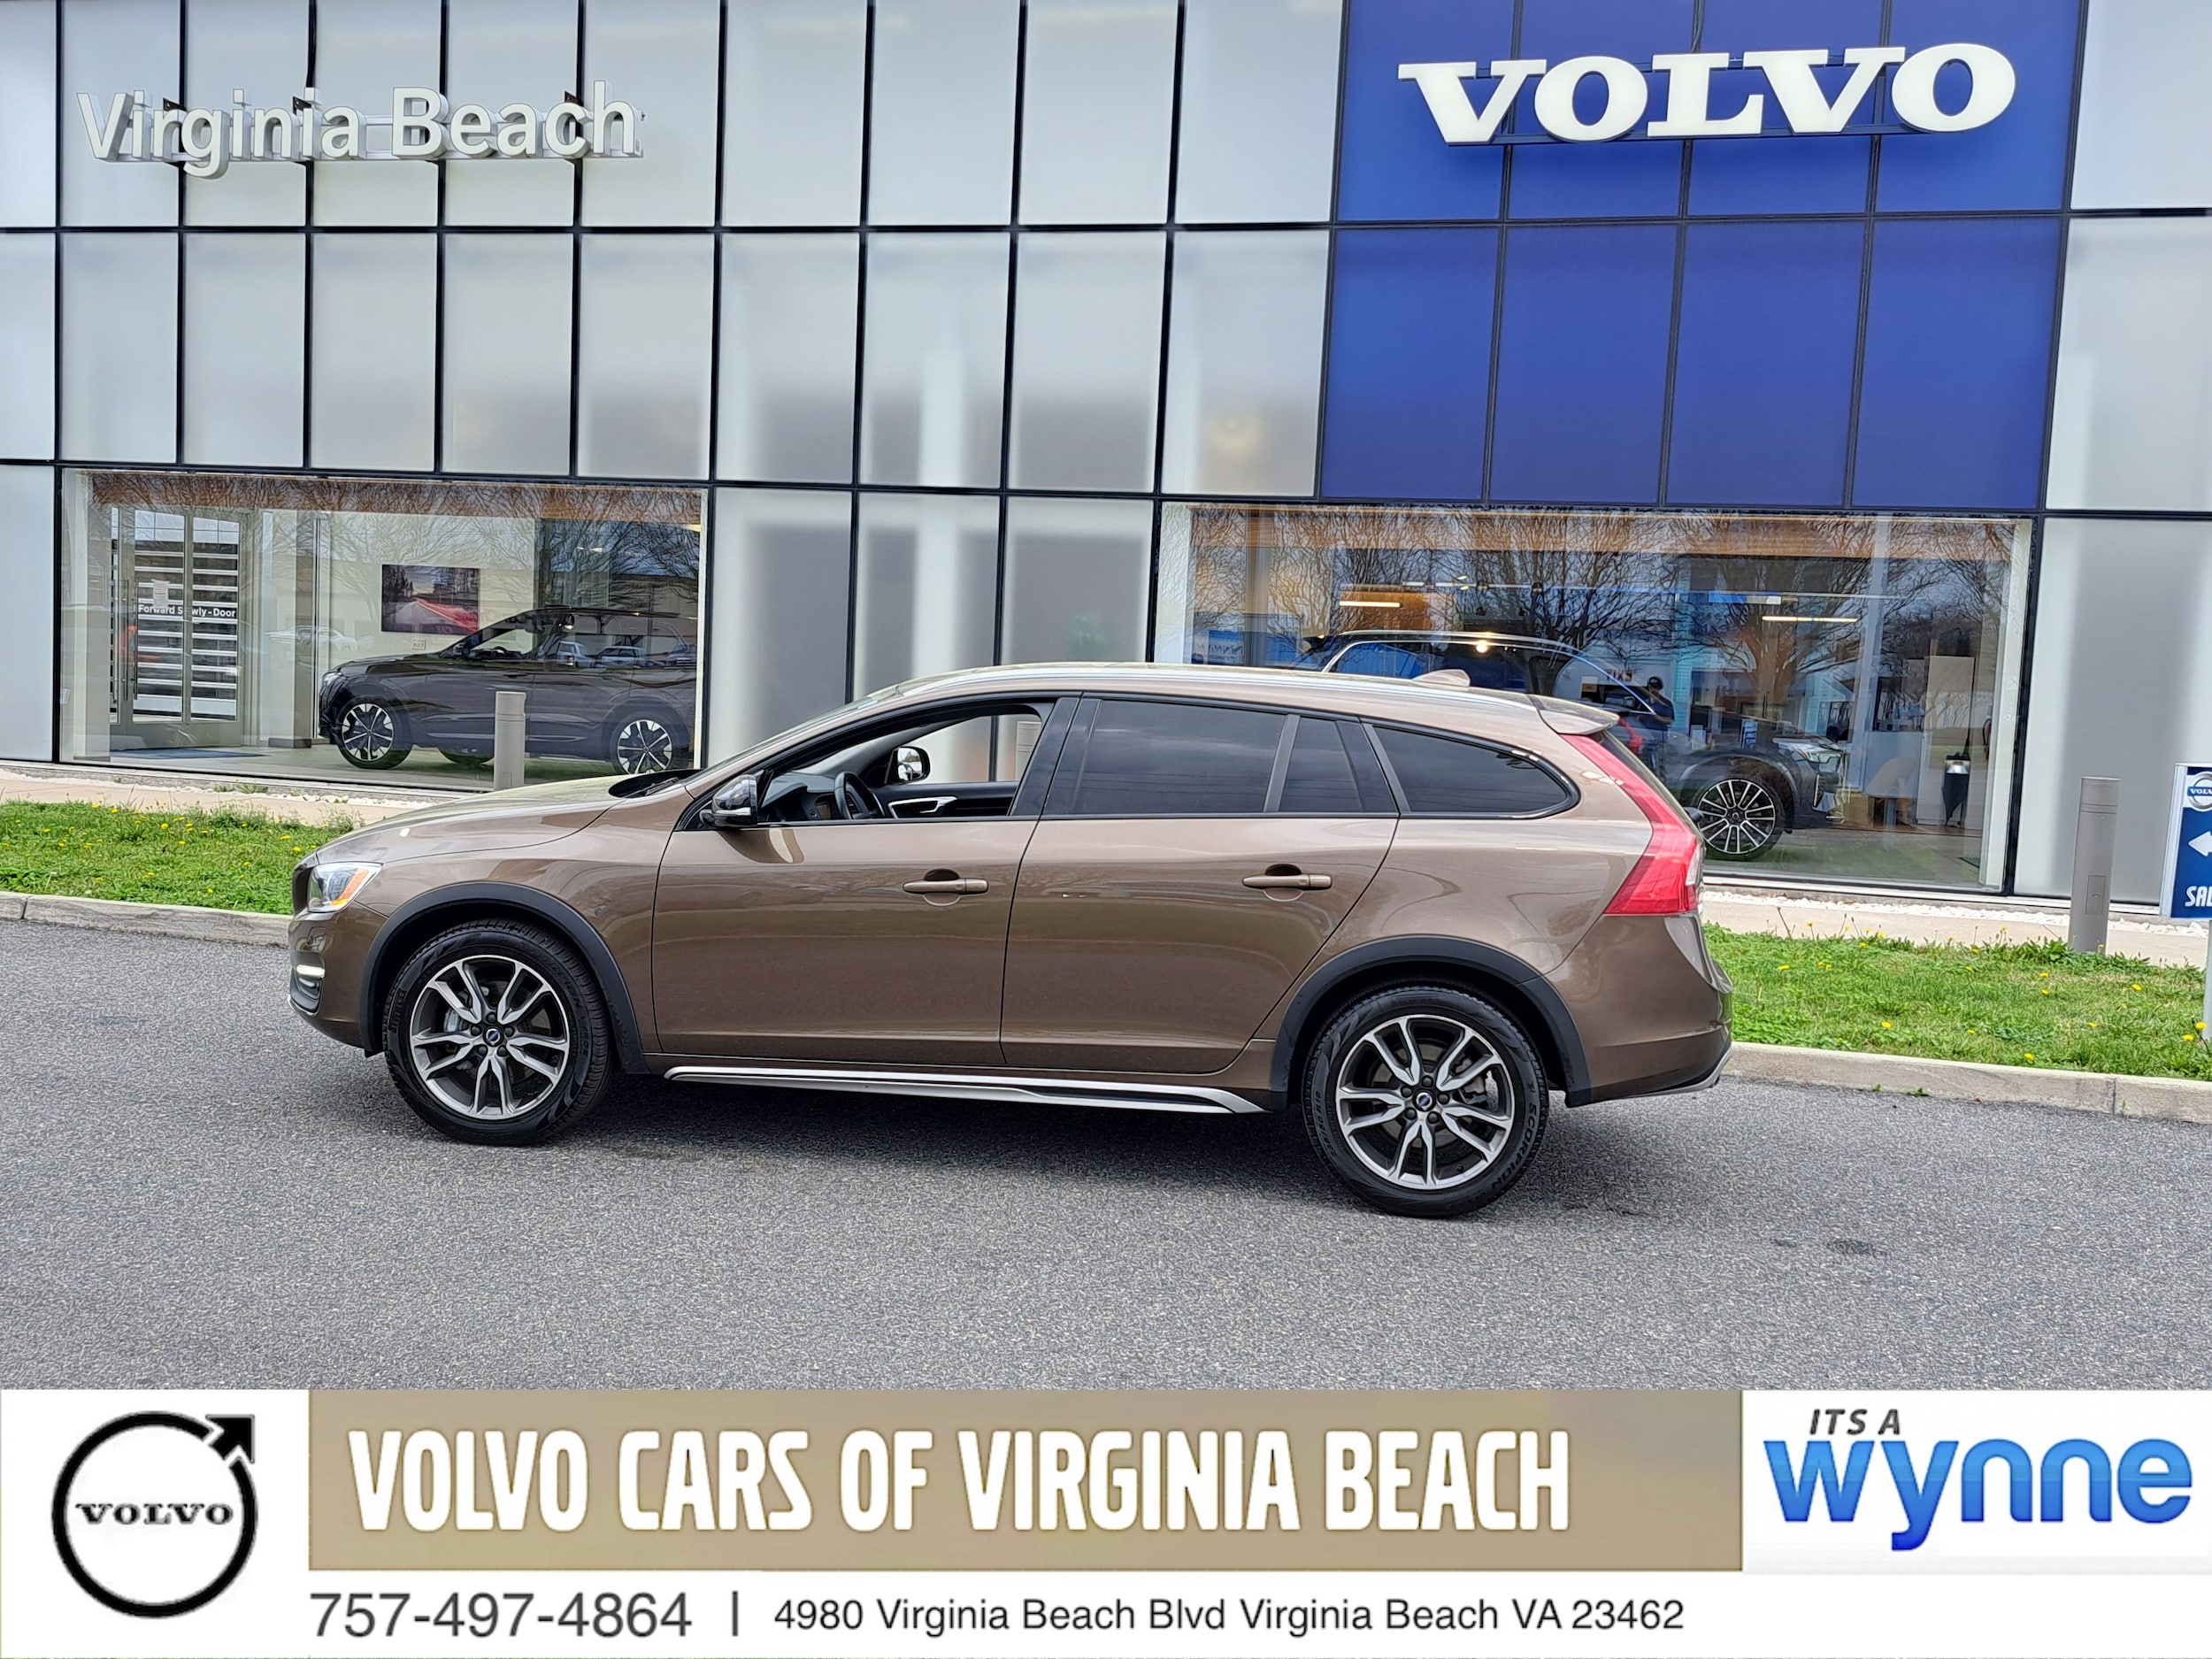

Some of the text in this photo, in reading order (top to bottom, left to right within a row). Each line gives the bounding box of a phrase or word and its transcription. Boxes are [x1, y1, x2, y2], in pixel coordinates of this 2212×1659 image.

[76, 80, 639, 179] Virginia Beach
[1398, 42, 2016, 144] VOLVO
[138, 604, 175, 615] Forward
[212, 608, 235, 618] Door
[1491, 1102, 1537, 1189] SCORPION
